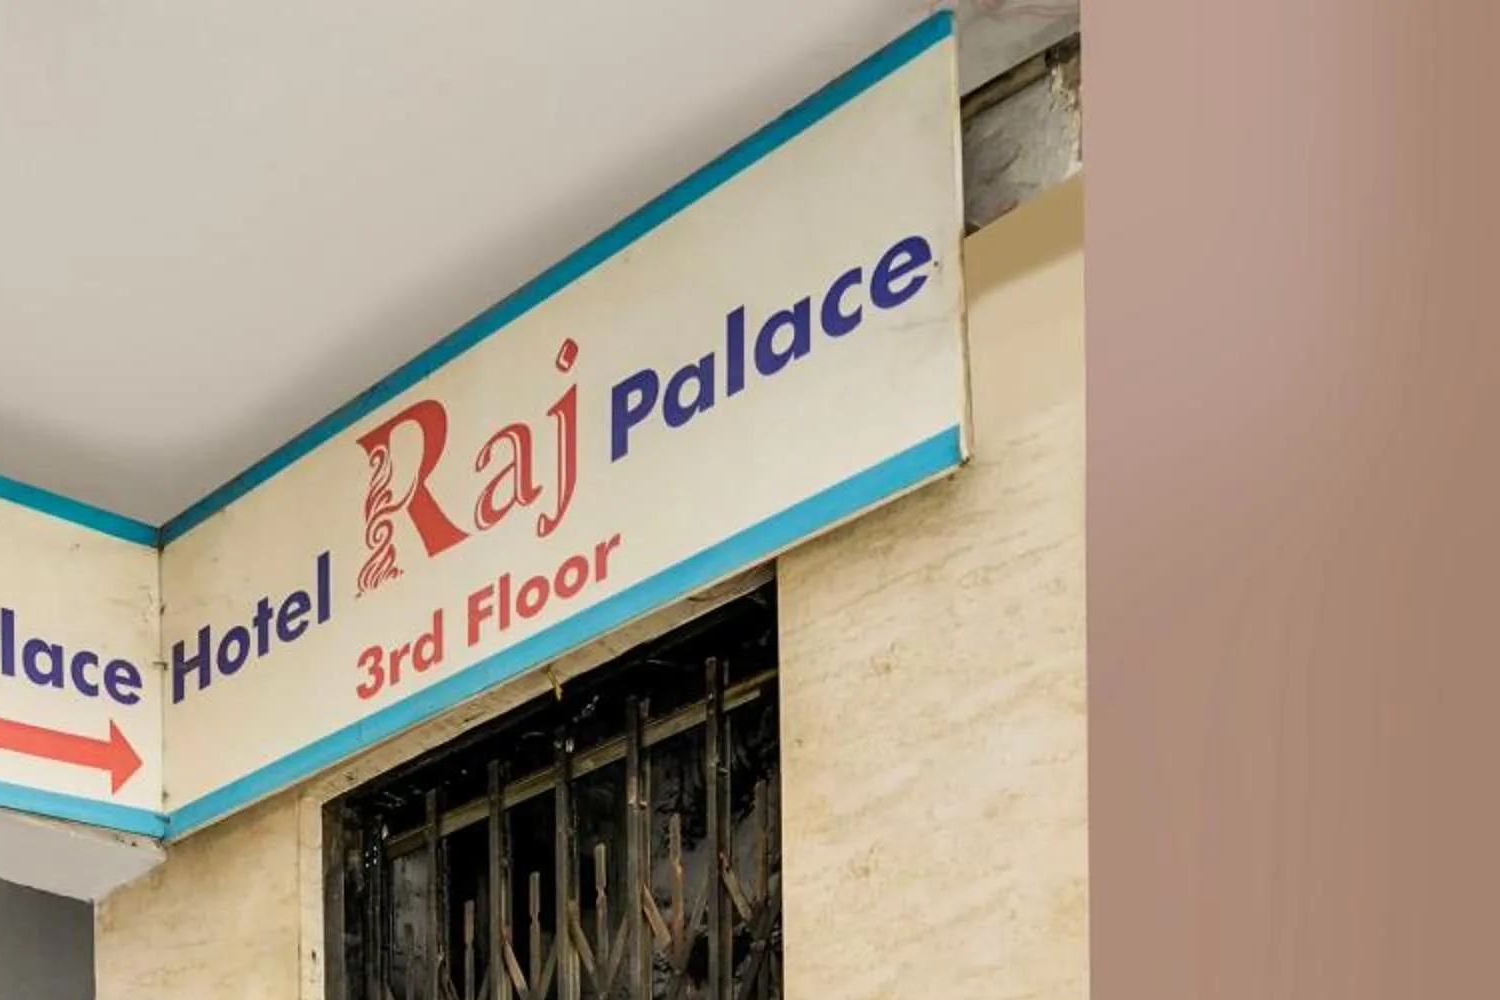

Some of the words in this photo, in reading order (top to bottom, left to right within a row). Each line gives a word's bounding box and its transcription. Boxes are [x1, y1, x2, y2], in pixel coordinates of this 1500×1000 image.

[172, 552, 331, 704] Hotel
[354, 337, 580, 598] Raj
[610, 234, 933, 463] Palace
[355, 608, 445, 702] 3rd
[465, 534, 622, 647] Floor
